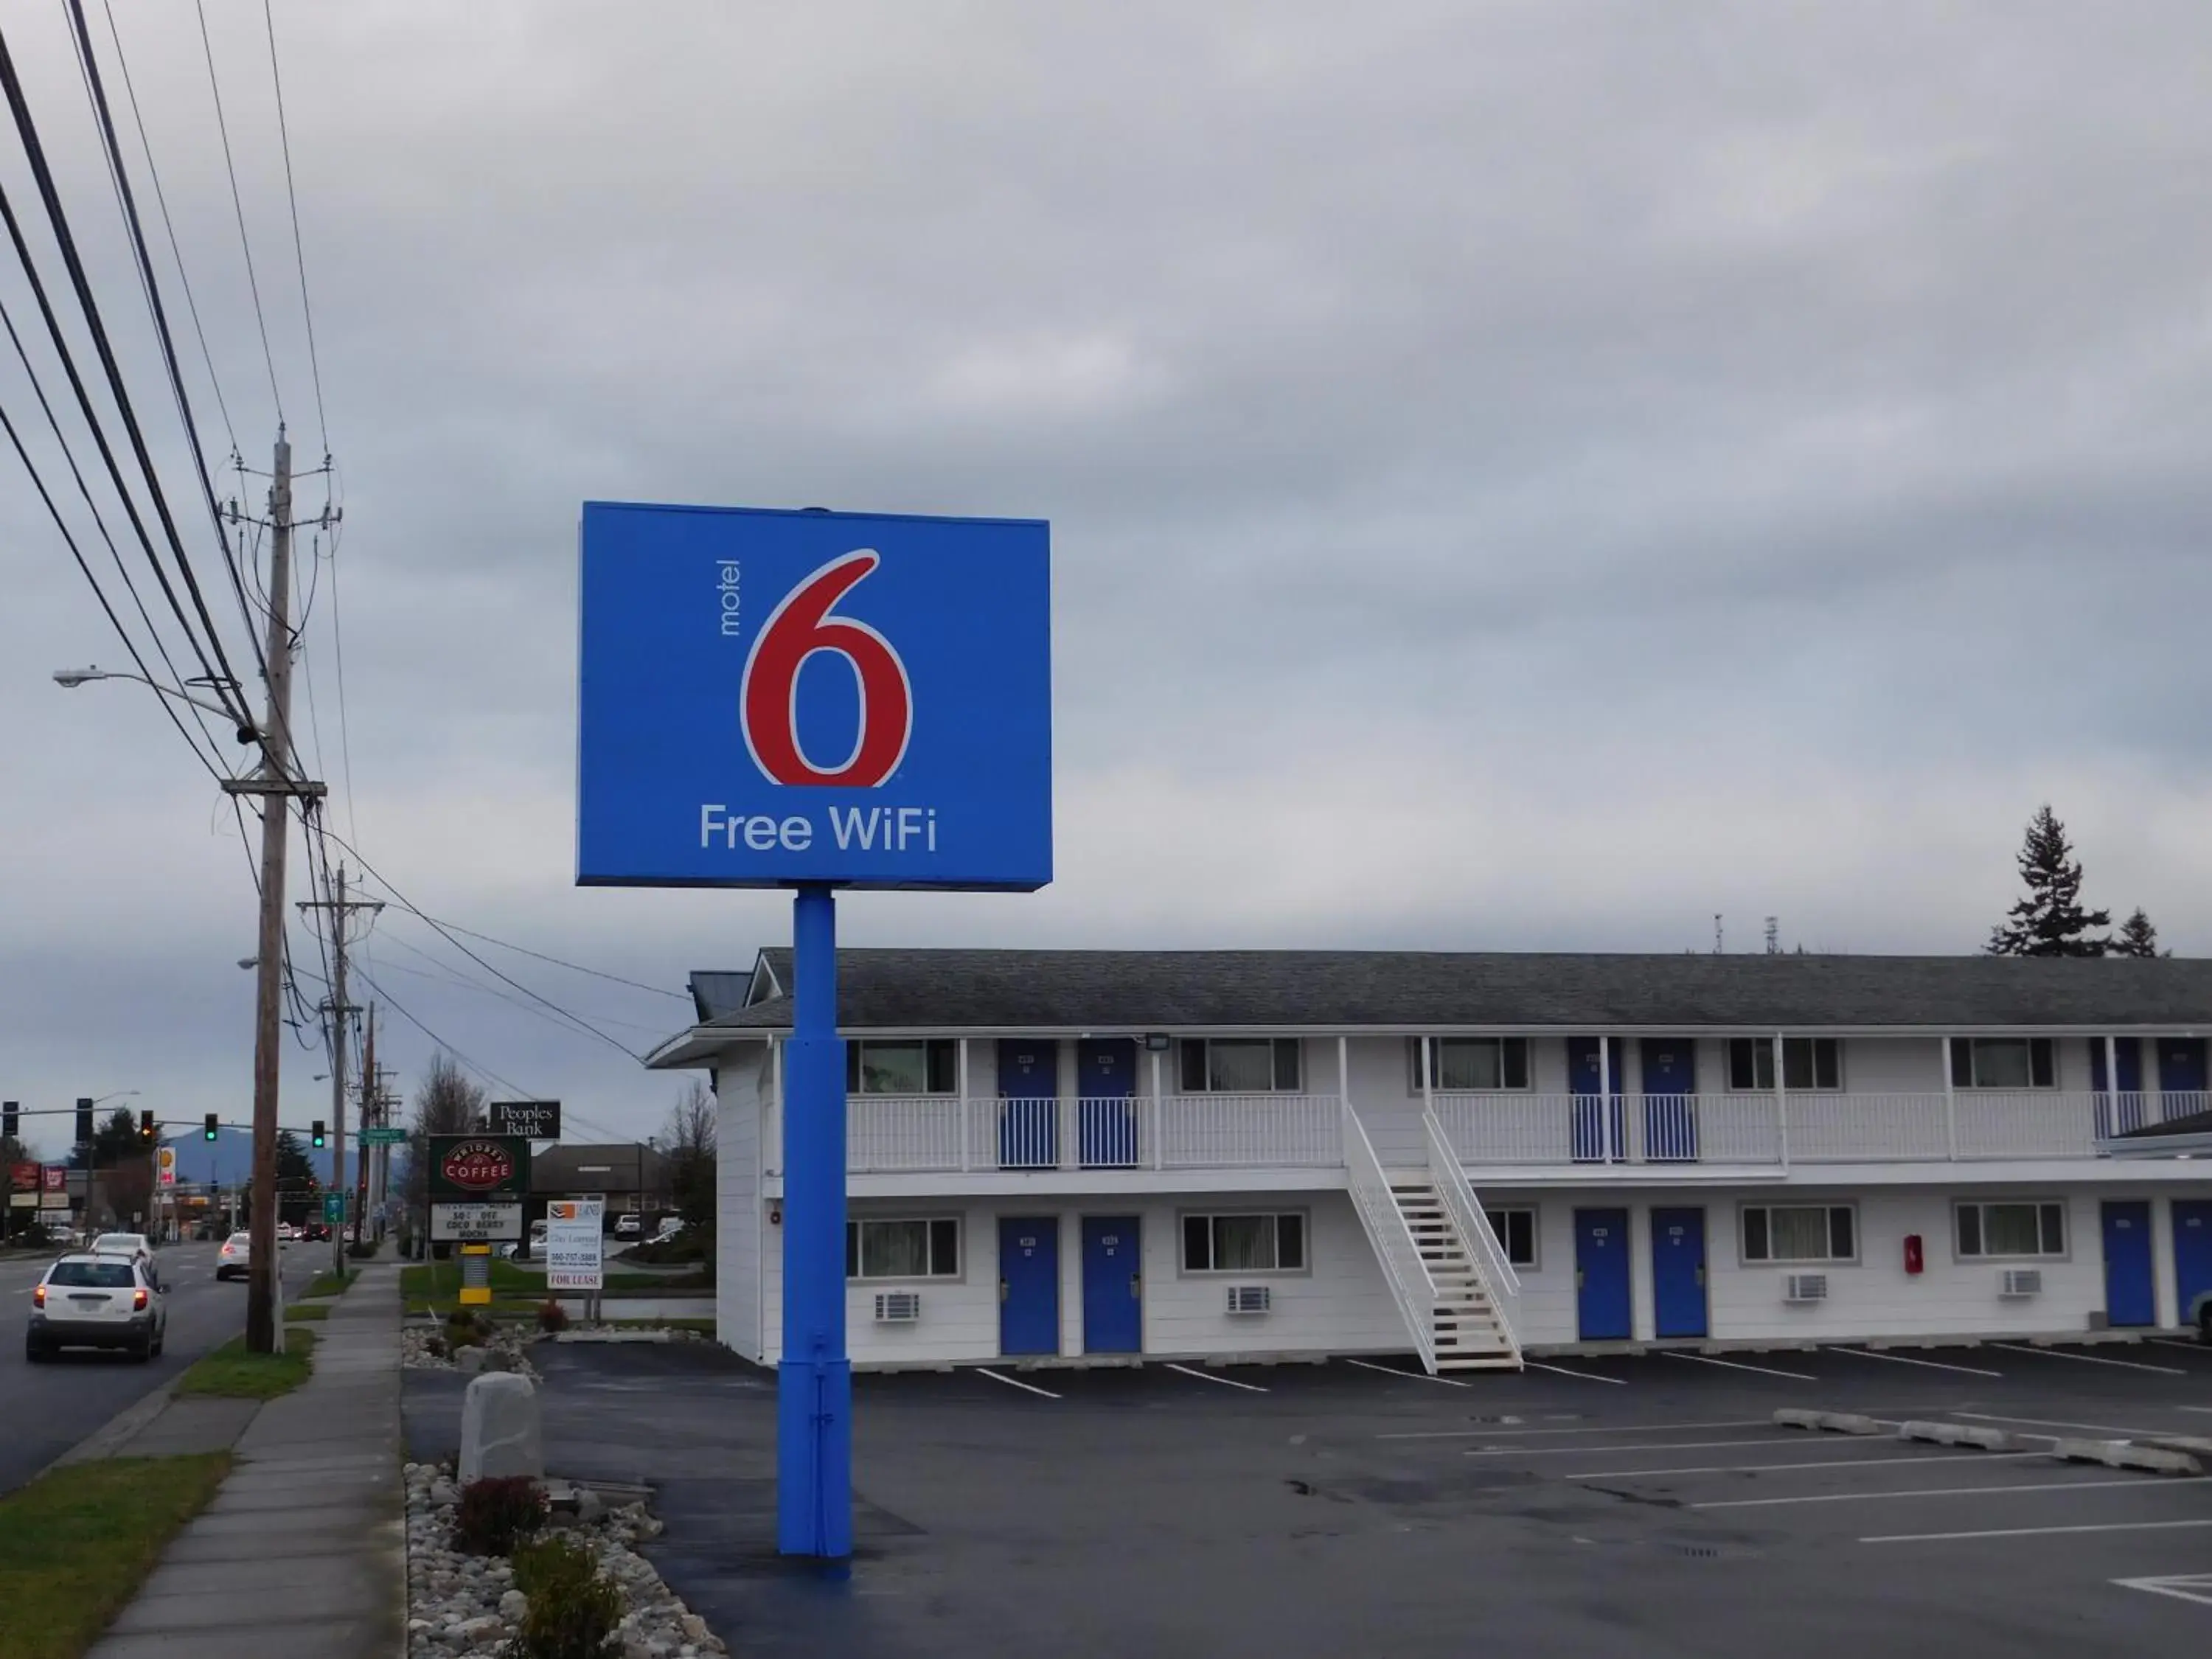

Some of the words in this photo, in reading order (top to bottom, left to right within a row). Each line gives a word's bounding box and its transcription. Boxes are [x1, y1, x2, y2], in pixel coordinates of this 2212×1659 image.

[716, 559, 740, 636] motel
[740, 548, 913, 788] 6
[700, 804, 813, 851] Free
[830, 805, 937, 852] WiFi
[498, 1105, 554, 1123] Peoples
[506, 1121, 543, 1135] Bank
[445, 1164, 509, 1178] COFFEE
[551, 1276, 570, 1286] FOR
[572, 1276, 599, 1286] LEASE
